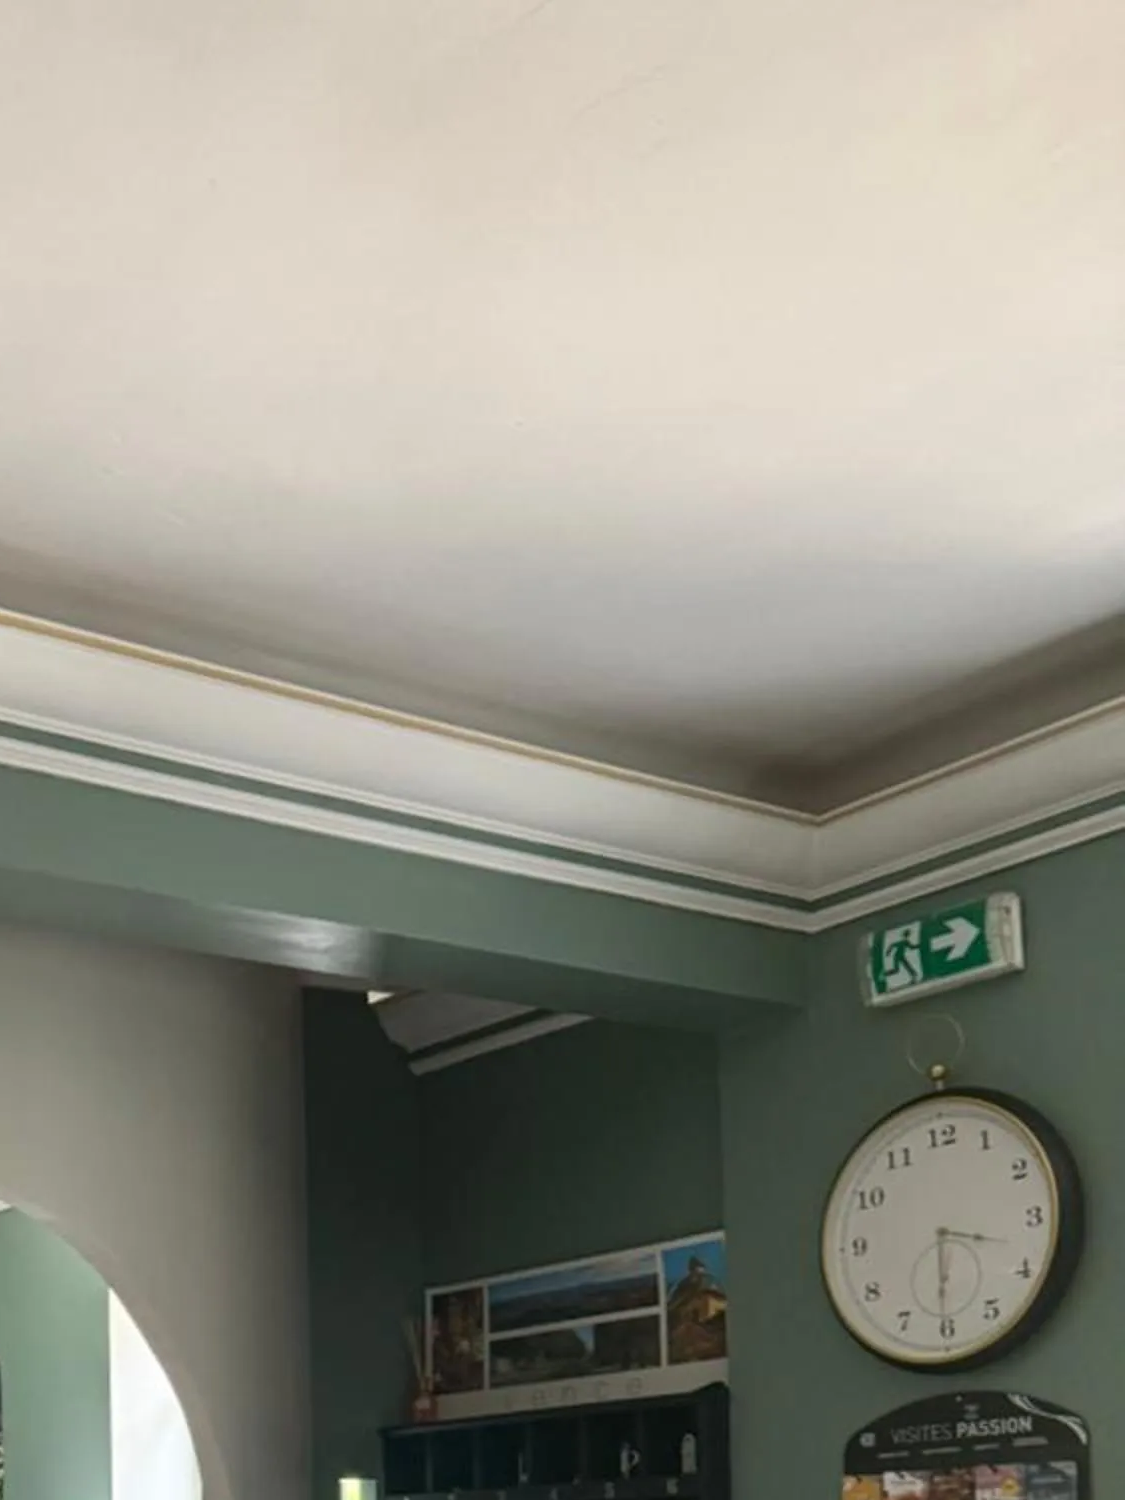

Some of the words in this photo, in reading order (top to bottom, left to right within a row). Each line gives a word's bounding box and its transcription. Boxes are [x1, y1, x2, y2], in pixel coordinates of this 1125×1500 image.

[927, 1124, 957, 1149] 12
[979, 1130, 991, 1151] 1
[886, 1147, 913, 1170] 11
[1011, 1158, 1028, 1181] 2
[857, 1186, 886, 1210] 10
[1026, 1205, 1044, 1228] 3
[851, 1236, 868, 1257] 9
[1013, 1257, 1032, 1279] 4
[864, 1281, 882, 1303] 8
[982, 1297, 1001, 1321] 5
[896, 1310, 912, 1332] 7
[939, 1318, 955, 1339] 6
[889, 1422, 954, 1444] VISITES
[955, 1415, 1034, 1439] PASSION
